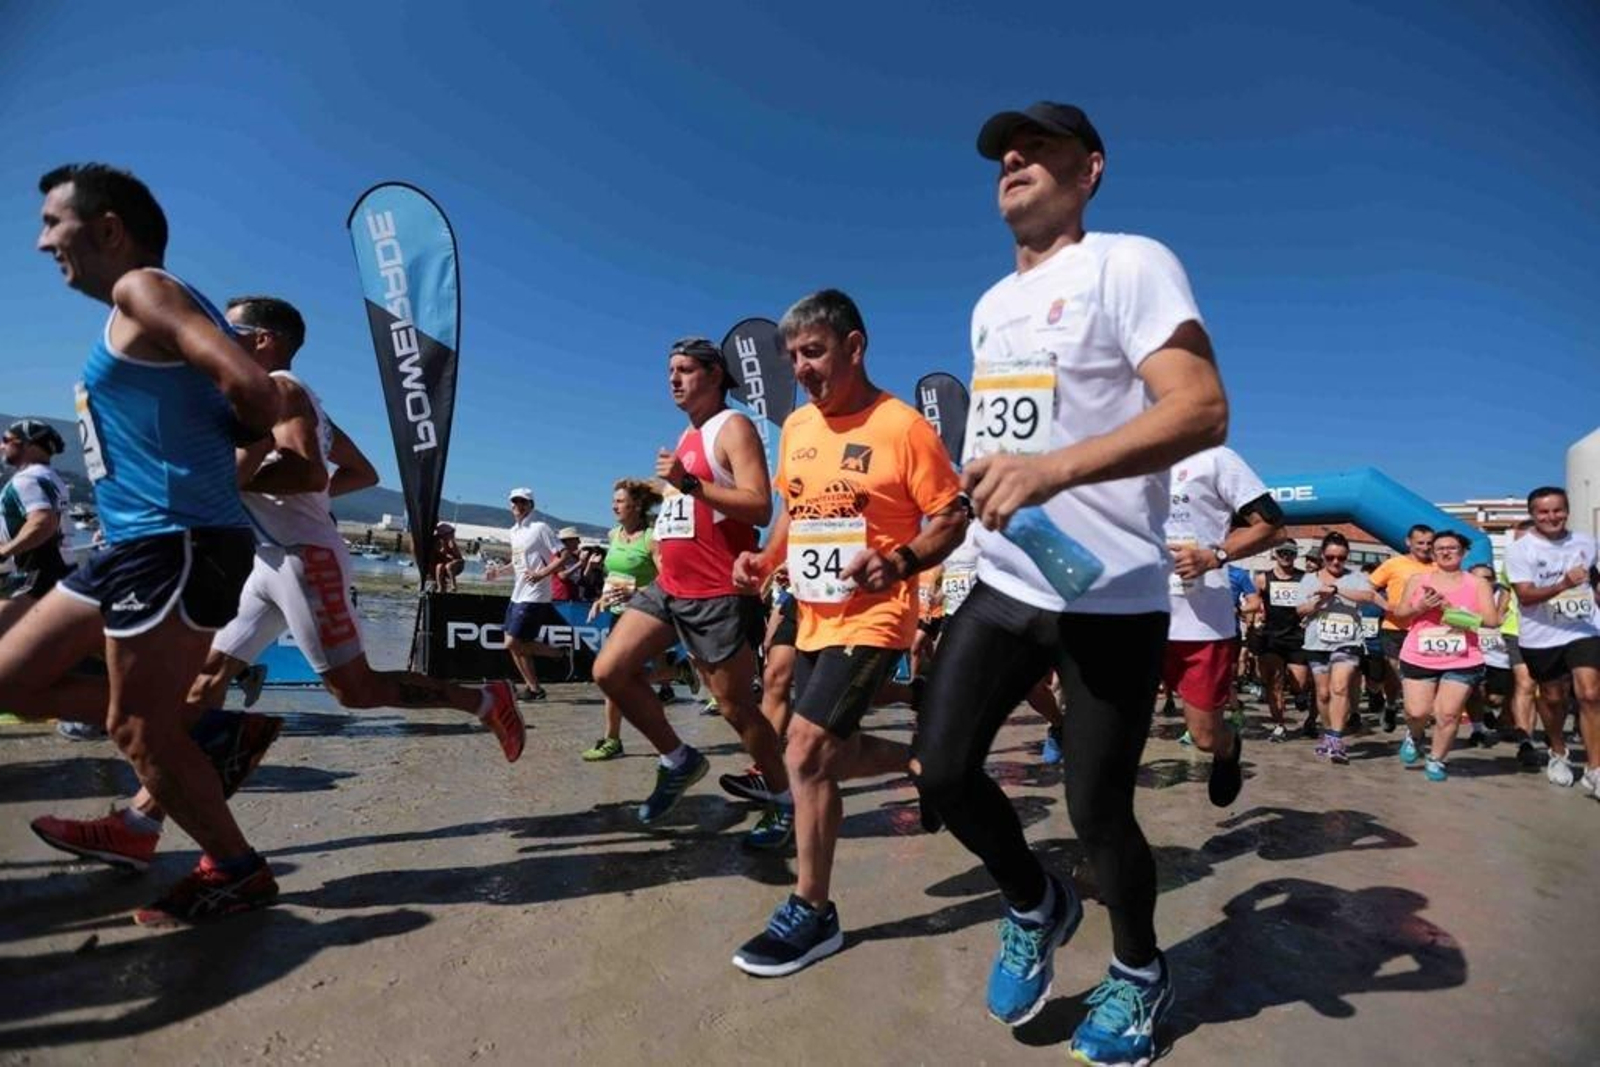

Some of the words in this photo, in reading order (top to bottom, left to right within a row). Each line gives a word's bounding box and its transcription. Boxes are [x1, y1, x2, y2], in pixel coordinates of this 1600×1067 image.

[802, 547, 843, 580] 34
[1553, 599, 1591, 614] 106
[447, 622, 609, 650] POER
[1321, 622, 1350, 635] 114
[1424, 639, 1461, 651] 197
